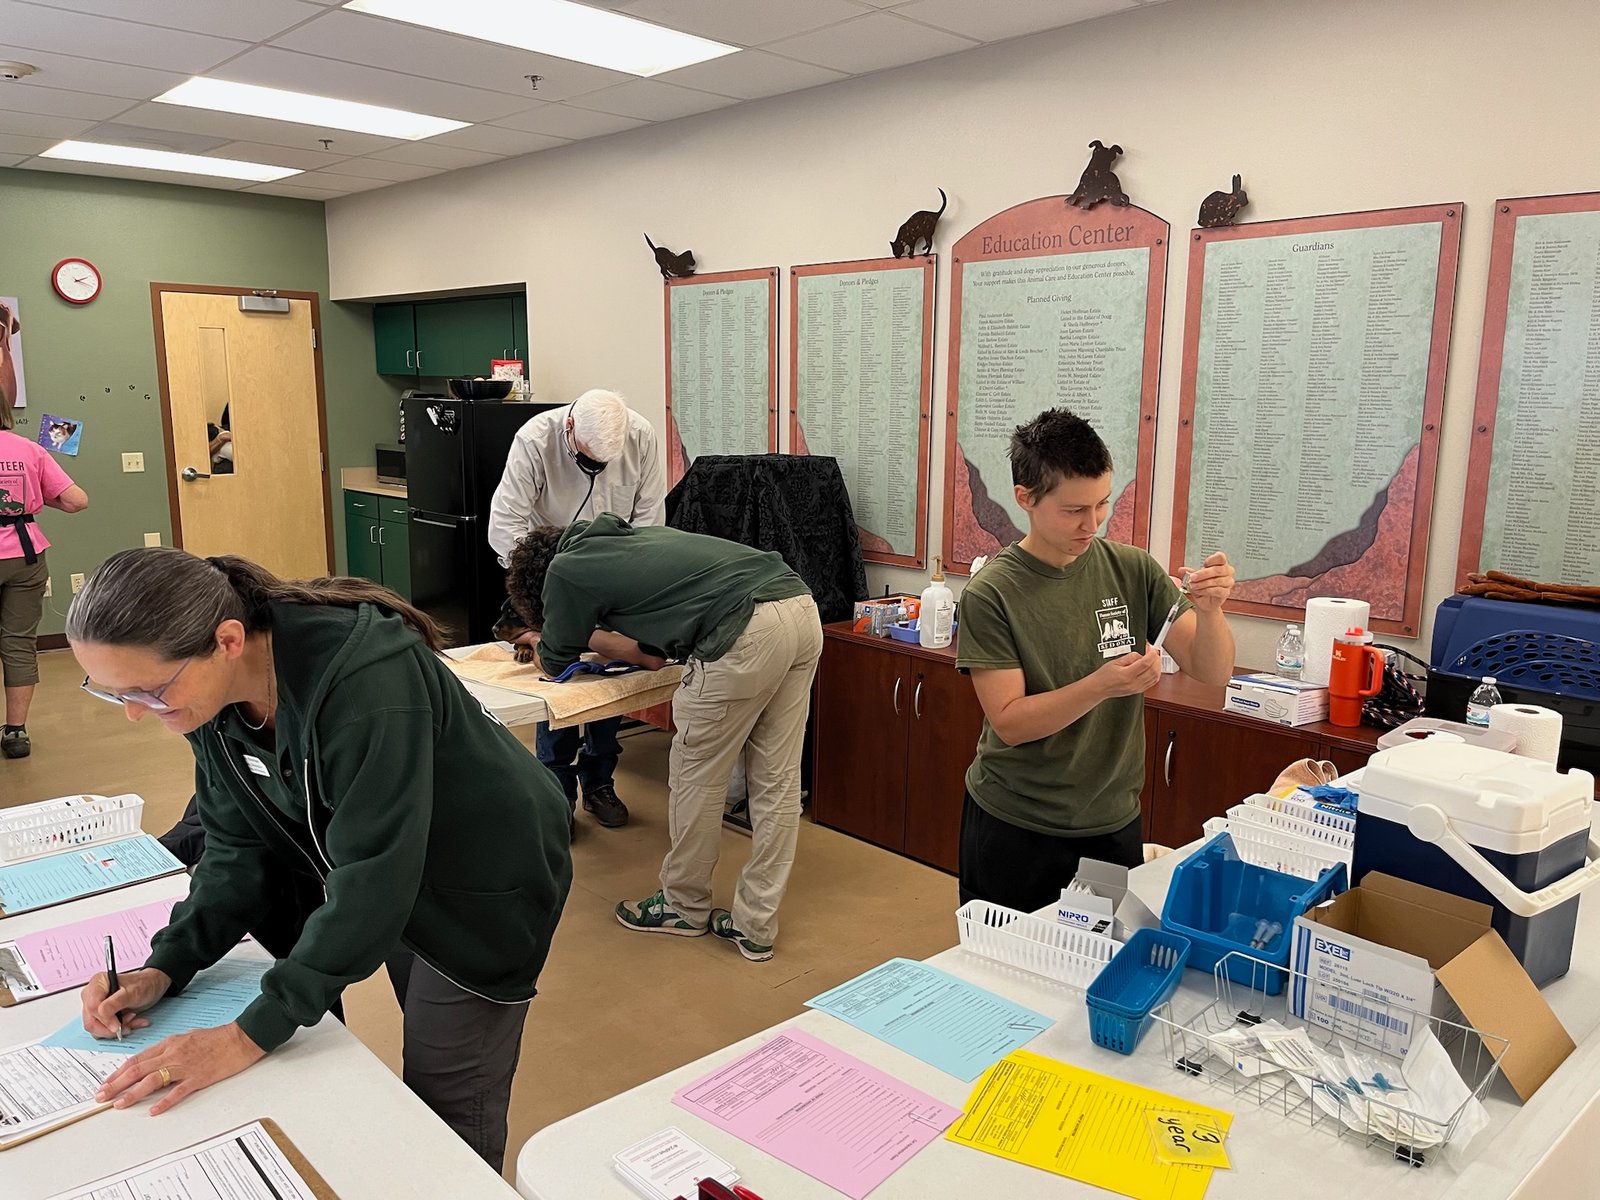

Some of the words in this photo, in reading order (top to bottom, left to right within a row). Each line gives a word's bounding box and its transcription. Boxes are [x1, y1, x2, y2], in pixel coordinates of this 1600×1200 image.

[983, 230, 1062, 255] Education
[1069, 223, 1134, 247] Center
[1292, 241, 1335, 252] Guardians
[1036, 266, 1065, 274] appreciation
[1027, 295, 1050, 304] Planned
[1052, 294, 1072, 302] Giving
[1102, 597, 1118, 607] STAFF
[1100, 640, 1132, 649] SEDONA
[1320, 804, 1351, 815] Nitrile
[1058, 909, 1089, 923] NIPRO
[1316, 938, 1349, 960] EXEL
[1317, 1016, 1329, 1024] 100
[1158, 1116, 1191, 1152] year
